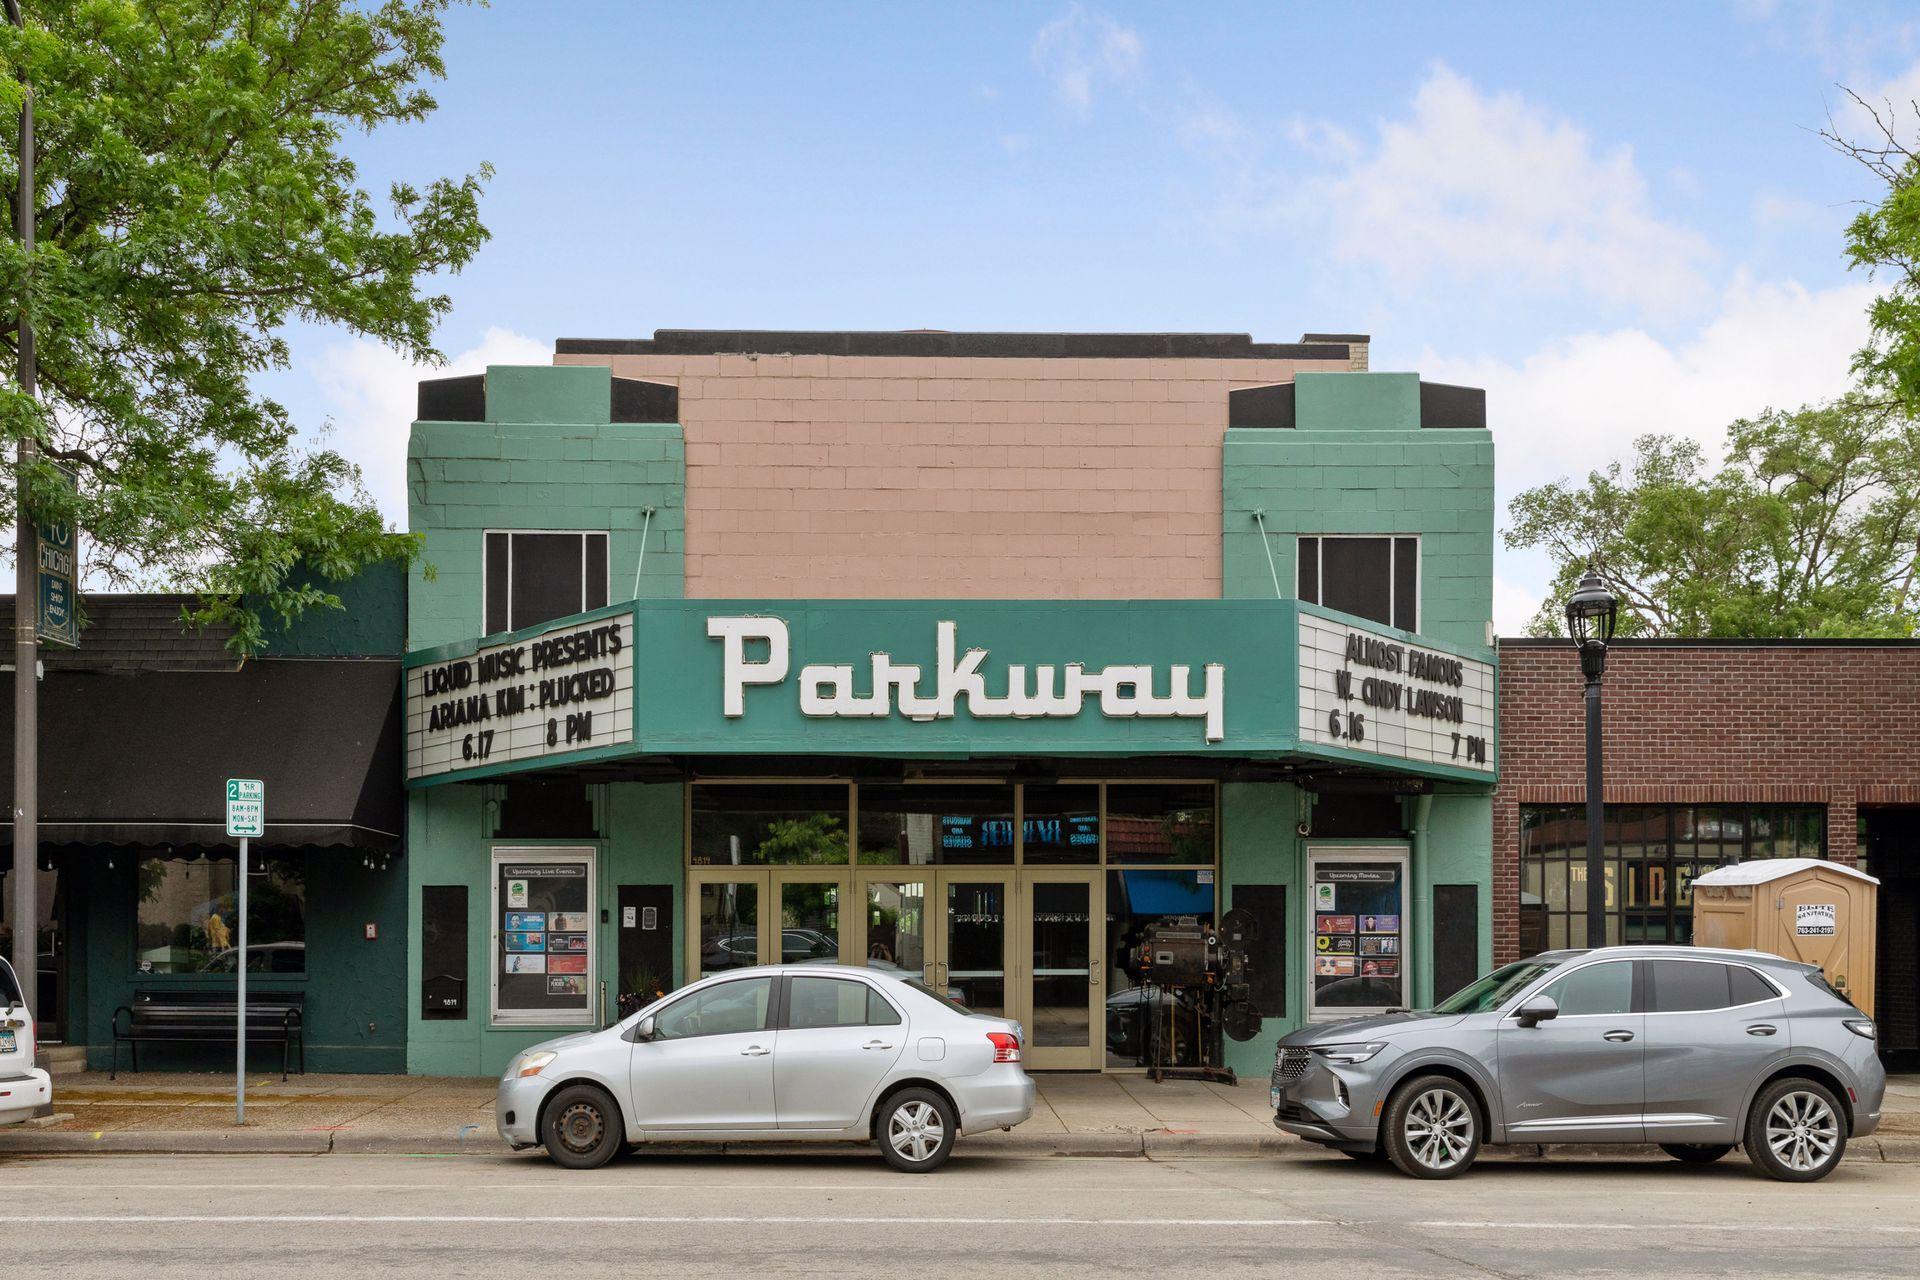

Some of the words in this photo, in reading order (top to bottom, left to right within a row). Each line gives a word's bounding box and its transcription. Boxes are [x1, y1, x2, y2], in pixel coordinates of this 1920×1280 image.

[424, 661, 472, 697] LIQUID
[478, 647, 525, 685] MUSIC
[532, 624, 622, 672] PRESENTS
[707, 615, 1224, 743] Parkway
[1346, 633, 1404, 673] ALMOST
[1409, 650, 1463, 687] FAMOUS
[429, 694, 491, 732] ARIANA
[539, 668, 615, 709] PLUCKED
[1336, 669, 1354, 700] W.
[1362, 677, 1403, 710] CINDY
[1407, 686, 1463, 724] LAWSON
[462, 730, 494, 760] 6.17
[547, 718, 557, 747] 8
[566, 711, 592, 744] PM
[1329, 708, 1364, 742] 6.16
[1451, 732, 1461, 760] 7
[1467, 735, 1485, 763] PM
[229, 783, 237, 798] 2
[512, 868, 541, 876] Upcoming
